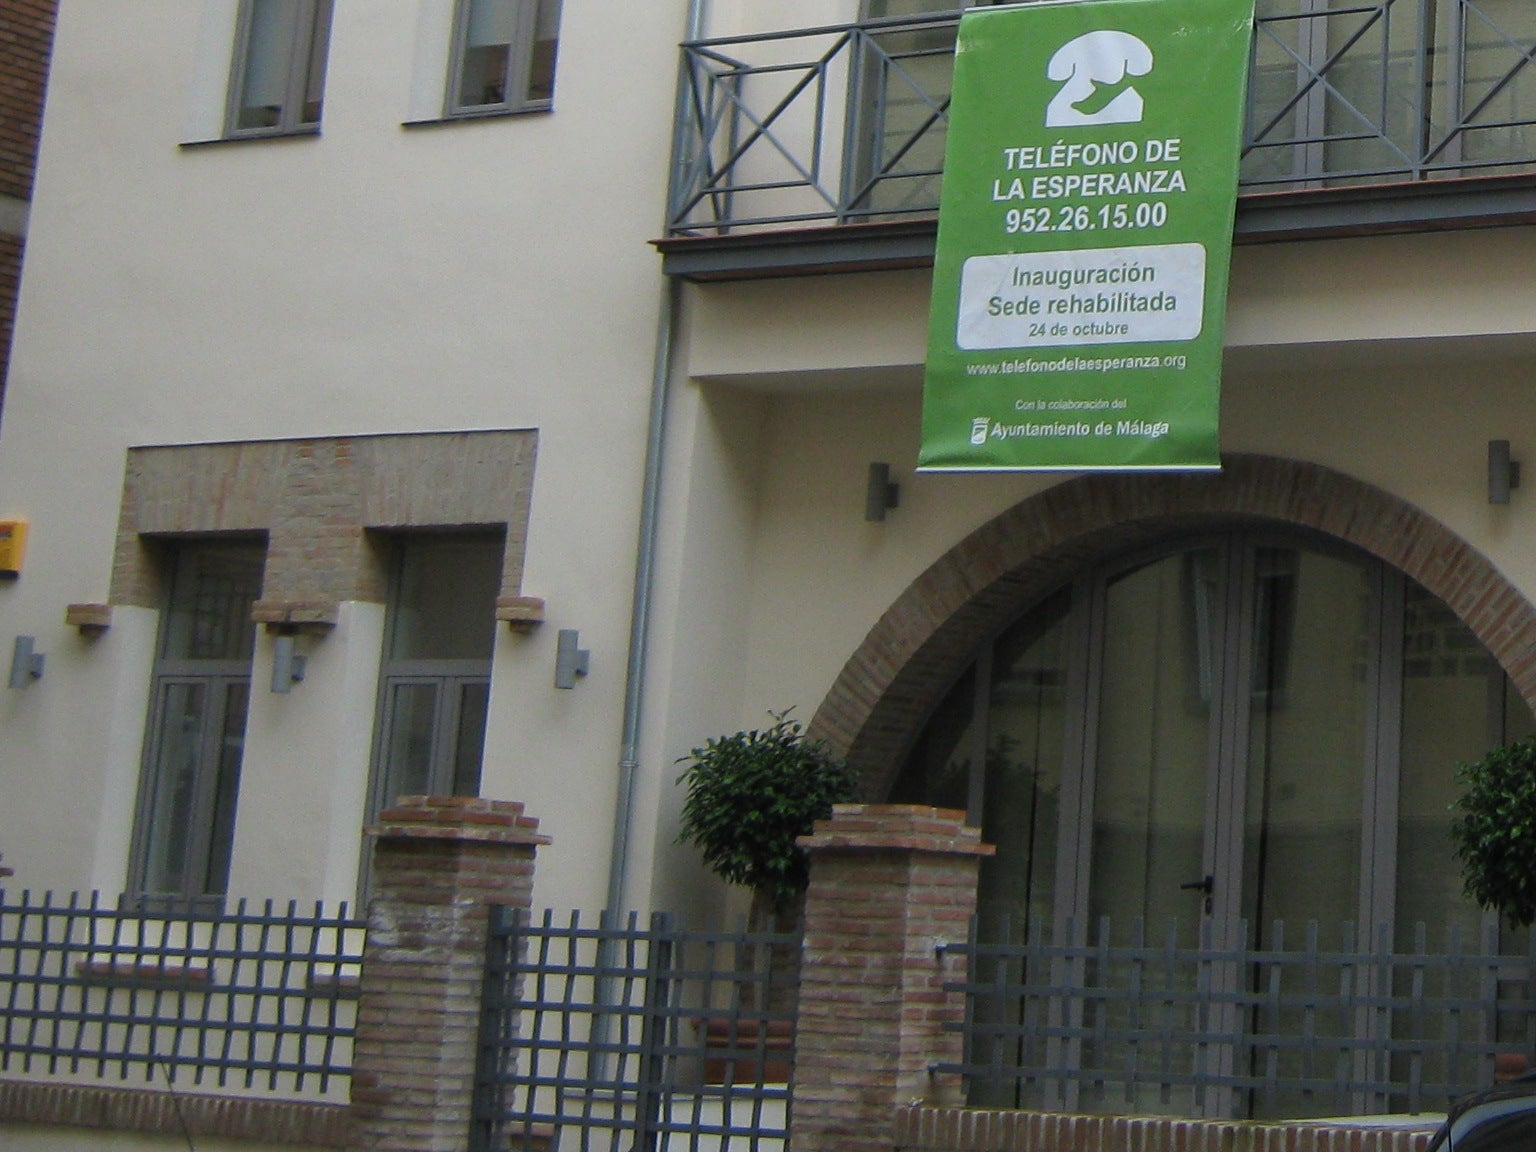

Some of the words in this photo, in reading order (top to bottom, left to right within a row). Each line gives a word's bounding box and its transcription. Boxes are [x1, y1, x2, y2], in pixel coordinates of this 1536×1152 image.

[1004, 139, 1138, 170] TELÉFONO
[1145, 138, 1181, 163] DE
[993, 178, 1025, 201] LA
[1032, 170, 1187, 199] ESPERANZA
[1005, 202, 1167, 233] 952.26.15.00
[1012, 262, 1155, 290] Inauguración
[988, 296, 1040, 317] Sede
[1048, 291, 1176, 314] rehabilitada
[1029, 323, 1045, 337] 24
[1050, 322, 1068, 336] de
[1072, 321, 1128, 336] octubre
[967, 355, 1186, 375] www.telefonodelaesperanza.org
[1015, 400, 1035, 410] Con
[1038, 400, 1045, 410] la
[1048, 399, 1109, 409] colaboración
[1111, 399, 1126, 409] del
[990, 420, 1090, 440] Ayuntamiento
[1095, 421, 1112, 435] de
[1117, 419, 1169, 438] Málaga
